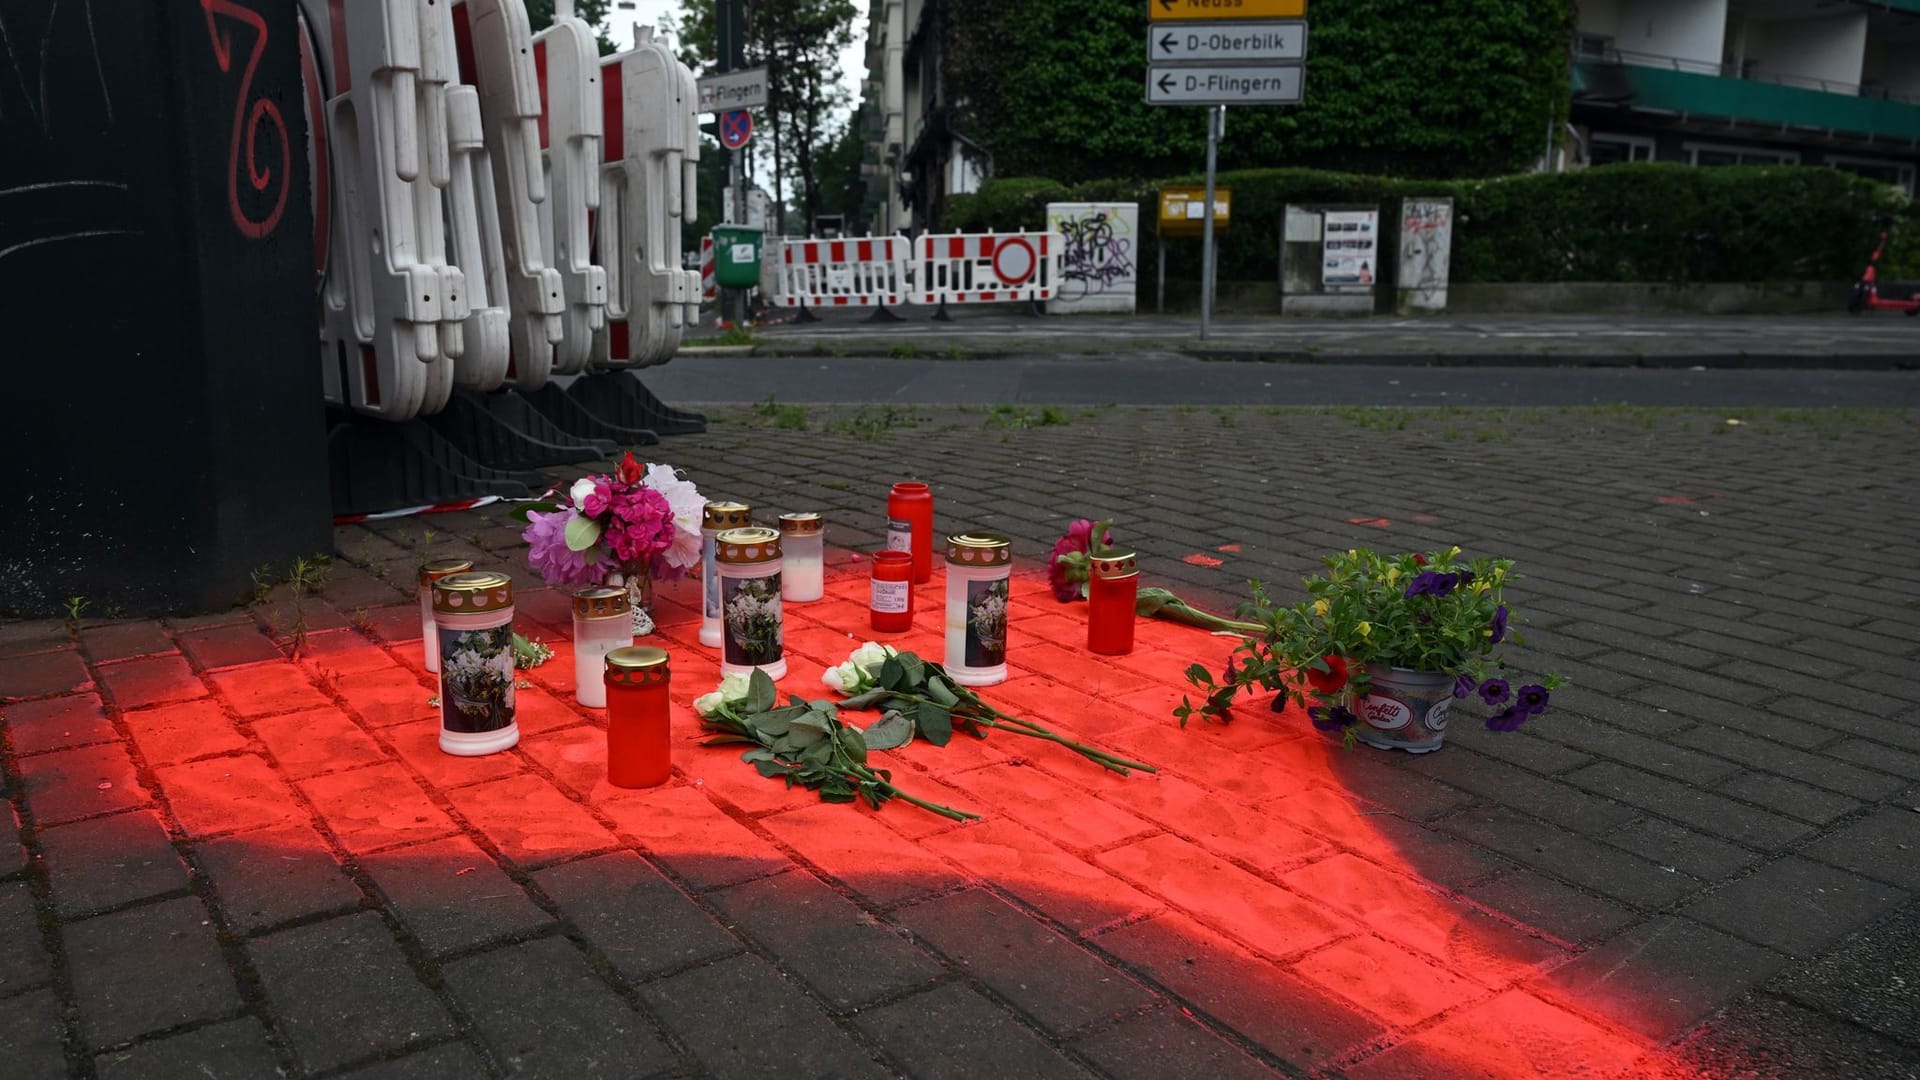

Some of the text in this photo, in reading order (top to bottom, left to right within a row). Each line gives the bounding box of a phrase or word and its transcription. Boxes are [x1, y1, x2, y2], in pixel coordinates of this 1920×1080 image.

[1187, 34, 1284, 51] D-Oberbilk
[717, 84, 760, 101] Flingern
[1185, 75, 1281, 94] D-Flingern
